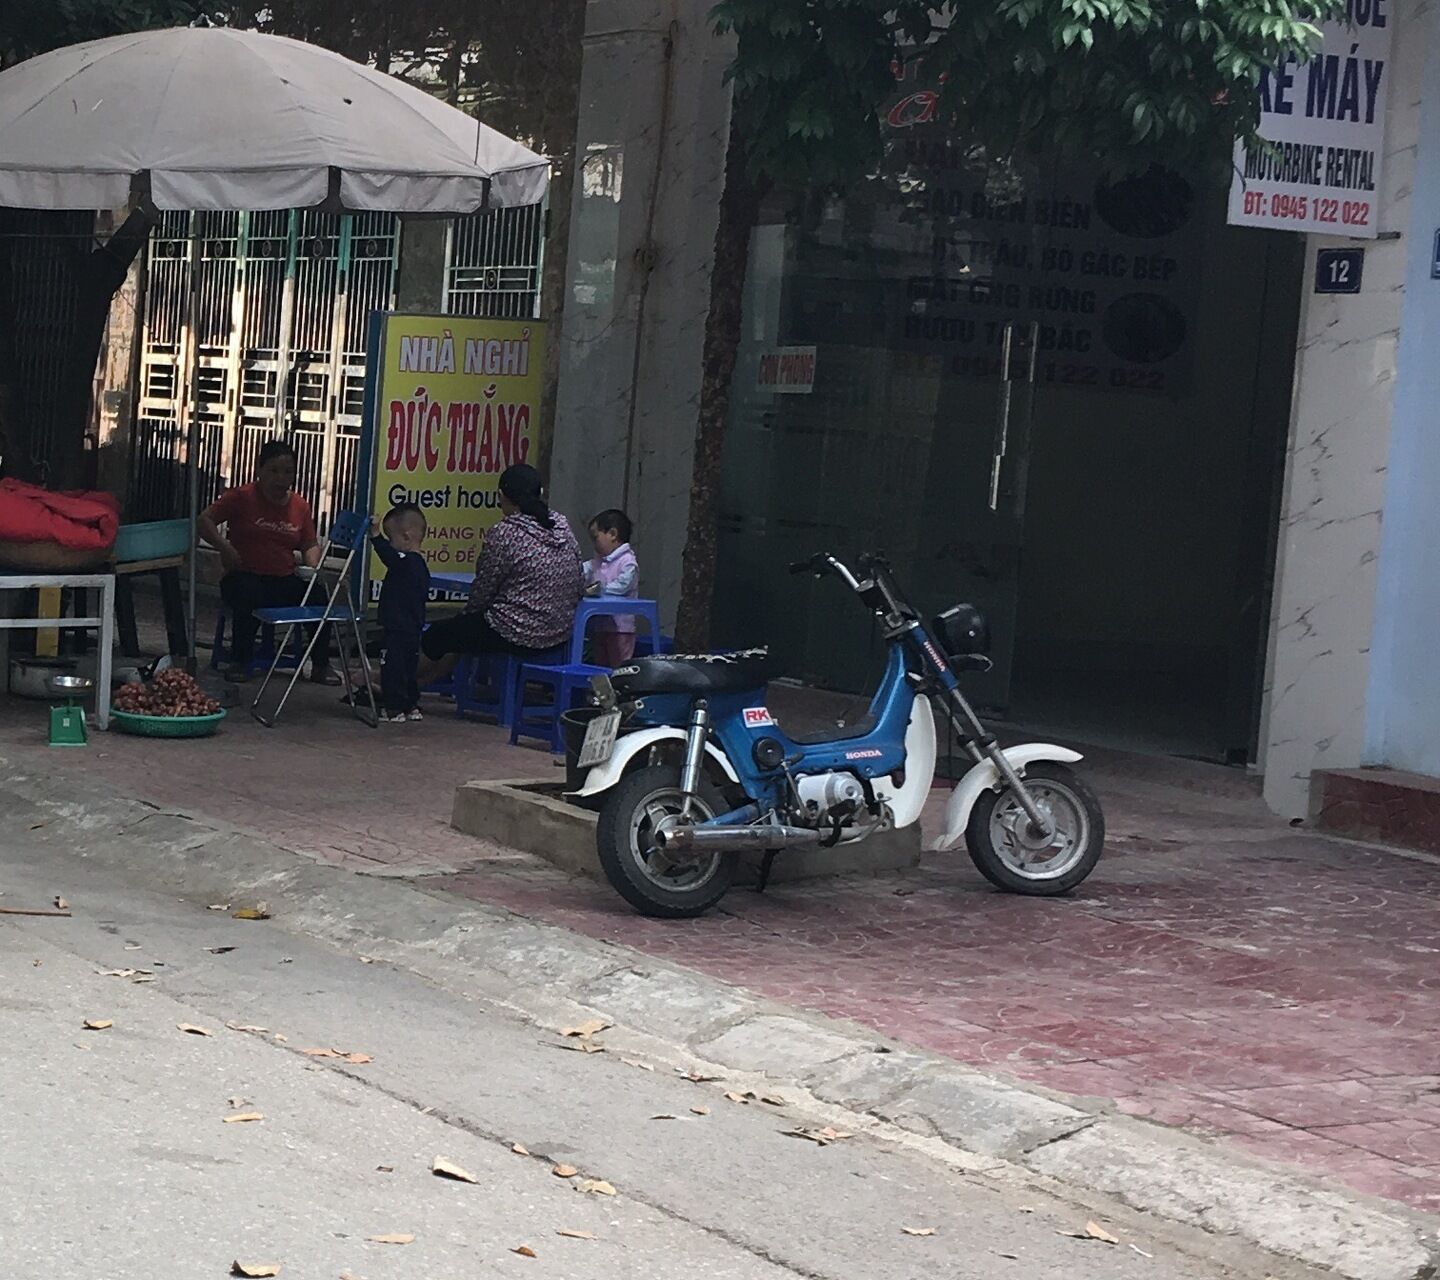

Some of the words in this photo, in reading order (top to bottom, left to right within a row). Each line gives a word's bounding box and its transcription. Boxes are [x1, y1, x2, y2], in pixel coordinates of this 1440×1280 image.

[1306, 43, 1384, 124] MÁY
[1244, 140, 1323, 186] MOTORBIKE
[1325, 146, 1375, 191] RENTAL
[1244, 191, 1267, 216] ĐT:
[1271, 194, 1308, 220] 0945
[1312, 198, 1338, 223] 122
[1341, 201, 1370, 226] 022
[1329, 260, 1350, 284] 12
[399, 329, 456, 374] NHÀ
[464, 326, 530, 376] NGHỈ
[385, 386, 442, 472] ĐỨC
[446, 383, 530, 474] THẮNG
[389, 483, 451, 508] Guest
[426, 526, 475, 540] HANG
[455, 544, 475, 563] ĐỂ
[745, 710, 771, 721] RK
[845, 749, 883, 760] HONDA
